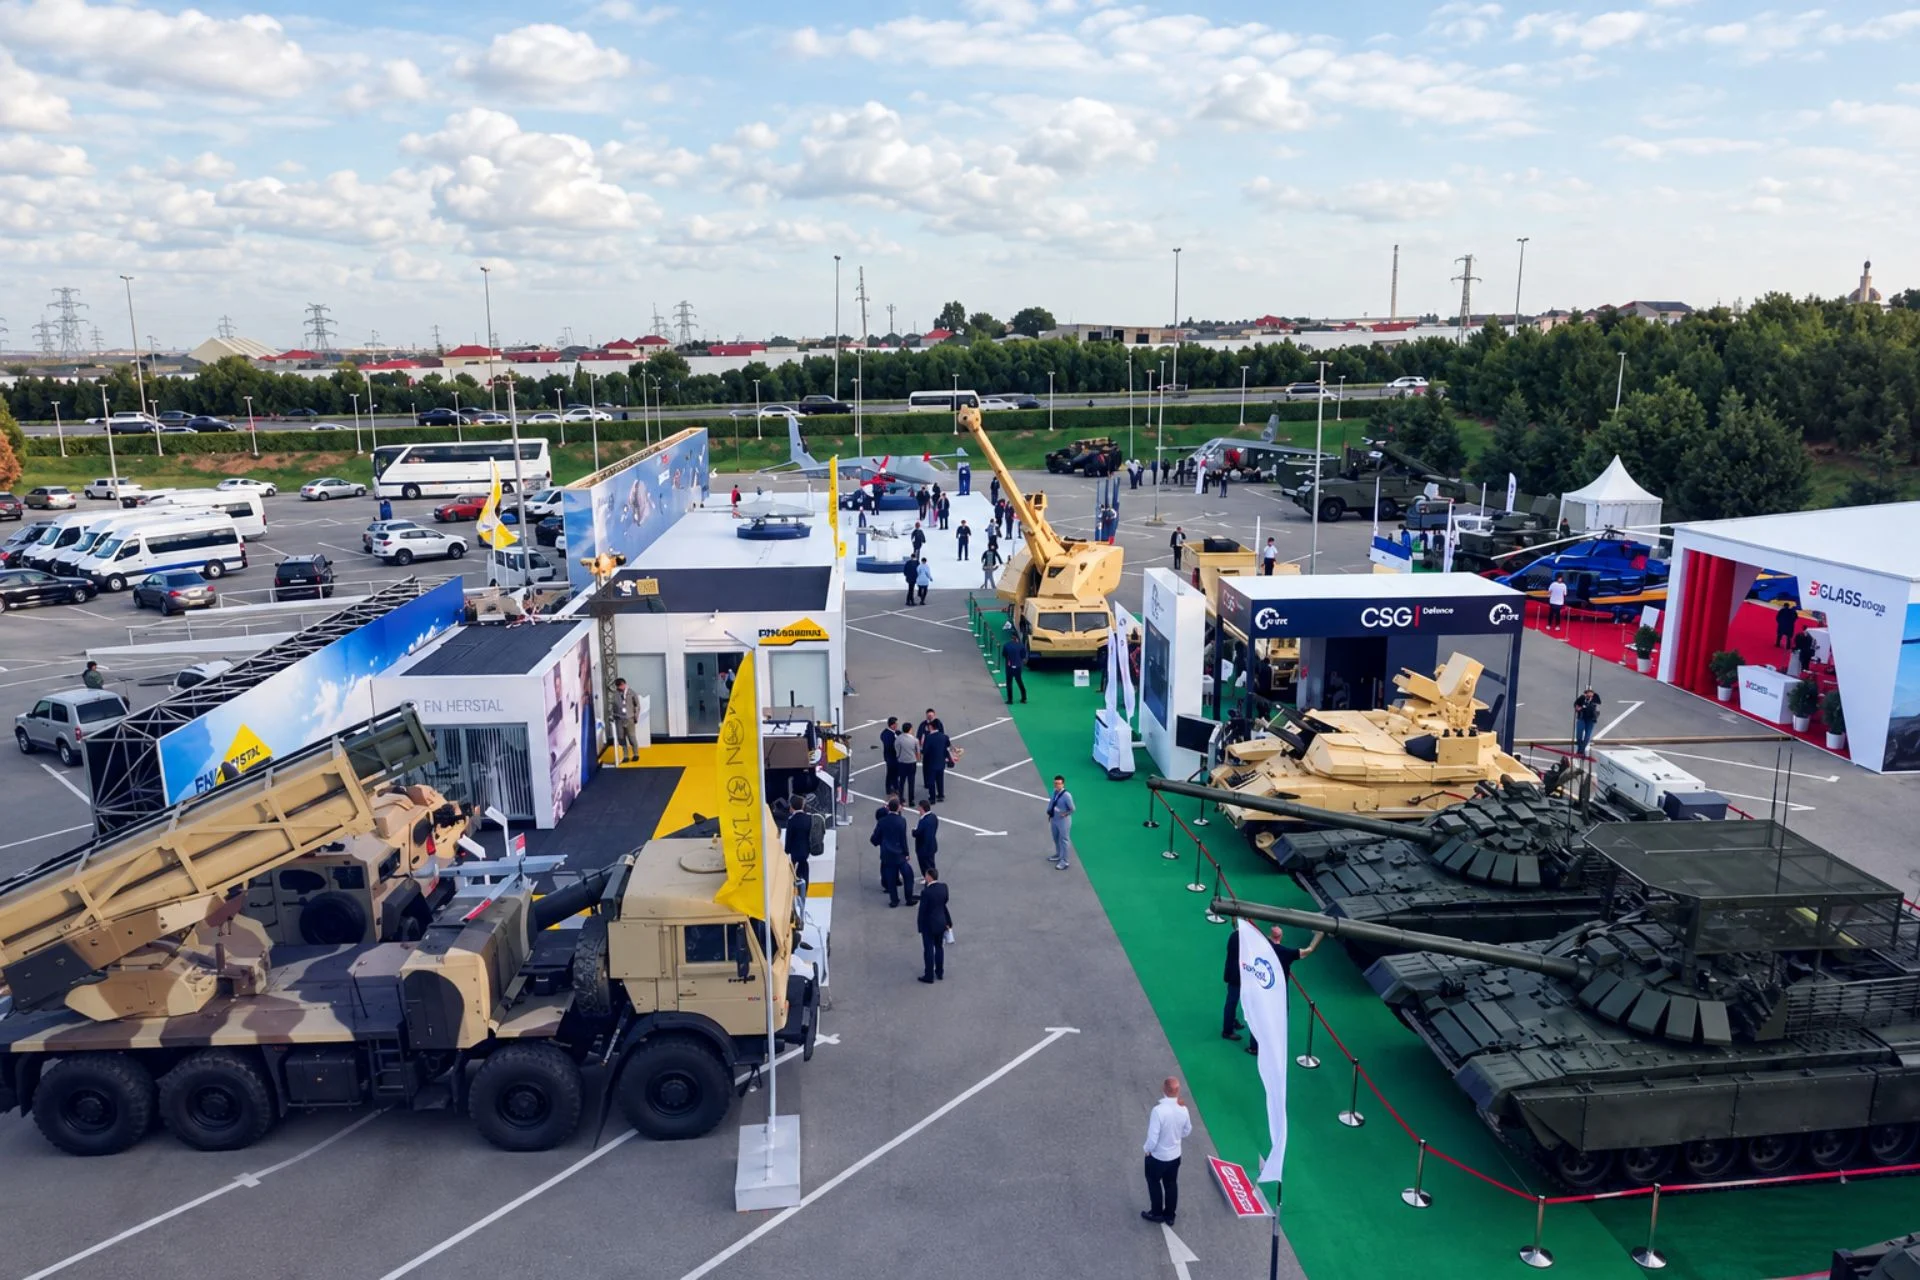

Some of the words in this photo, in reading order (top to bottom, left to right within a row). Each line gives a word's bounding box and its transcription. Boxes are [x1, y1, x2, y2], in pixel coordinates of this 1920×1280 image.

[1361, 607, 1412, 628] CSG
[424, 699, 442, 712] FN
[446, 699, 504, 712] HERSTAL
